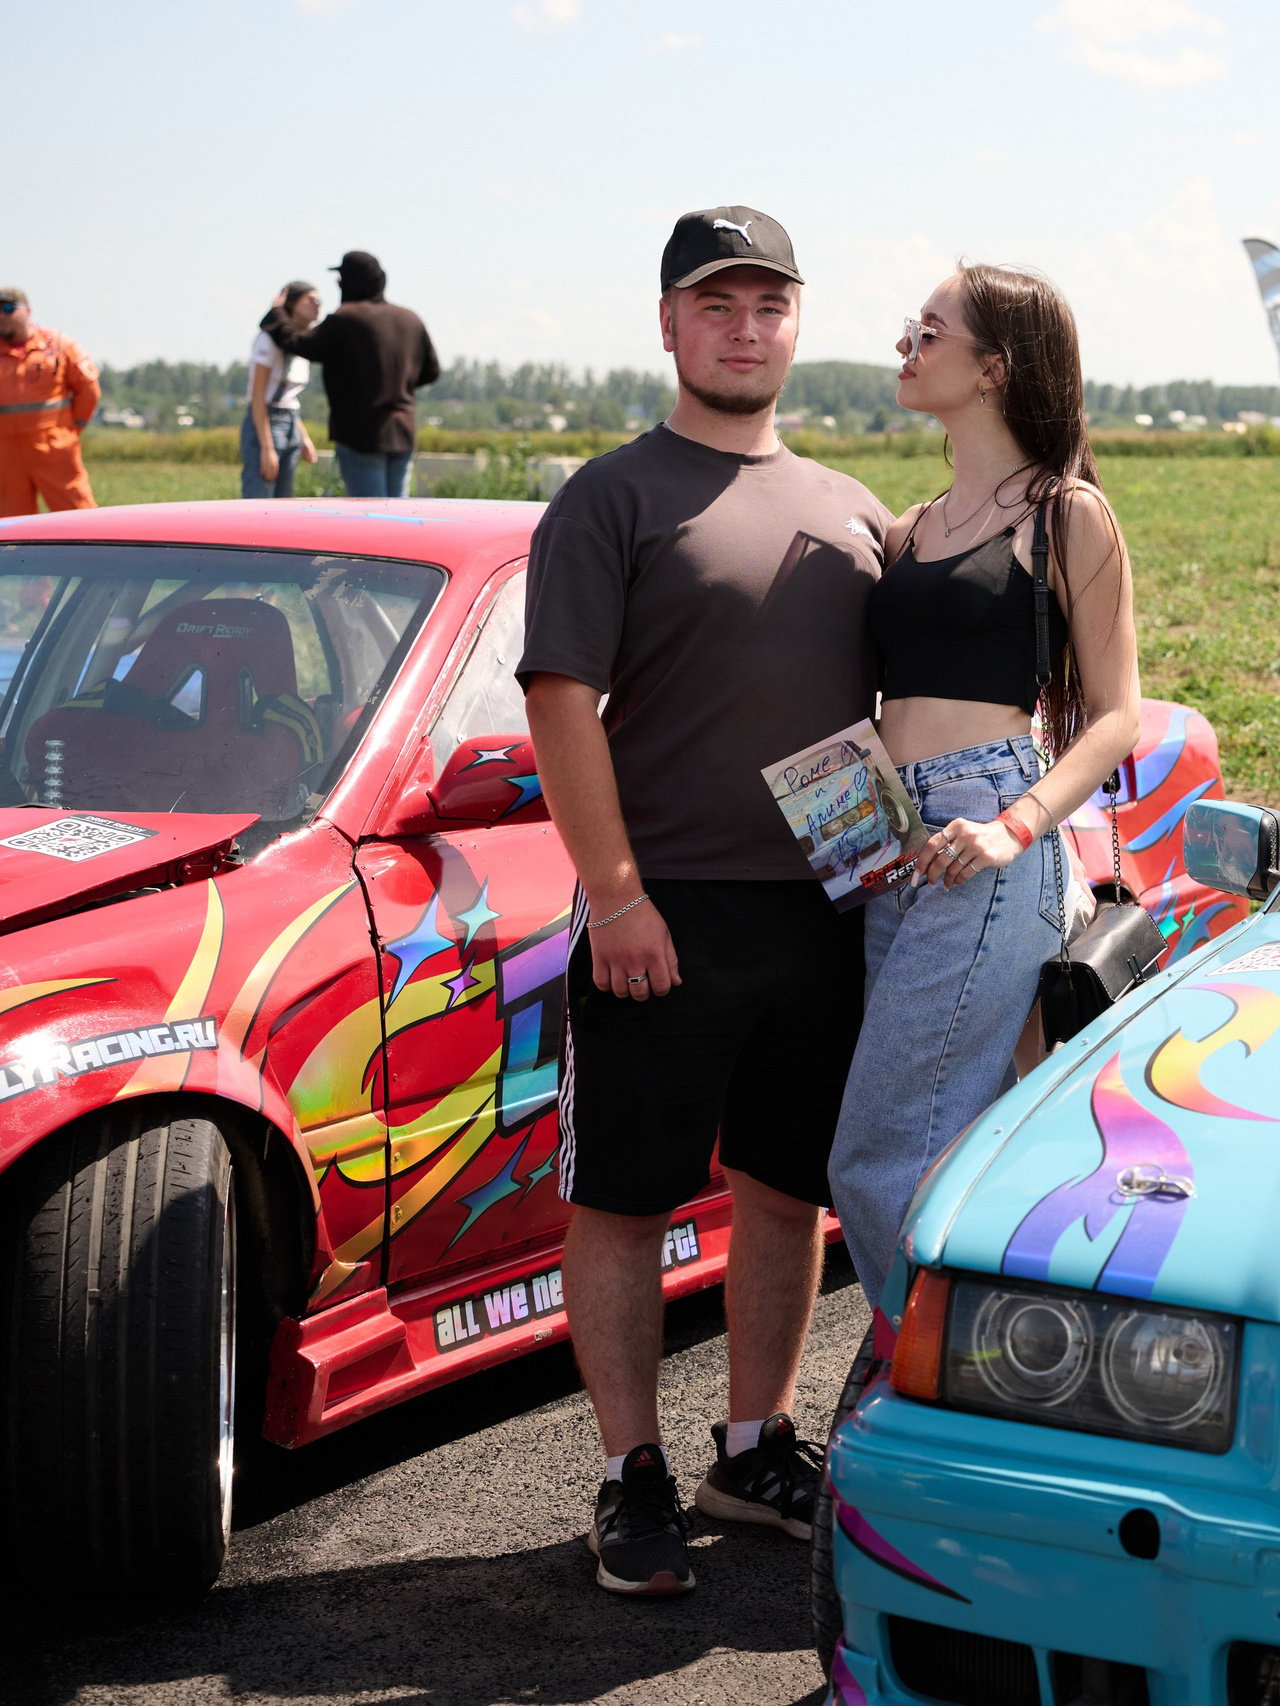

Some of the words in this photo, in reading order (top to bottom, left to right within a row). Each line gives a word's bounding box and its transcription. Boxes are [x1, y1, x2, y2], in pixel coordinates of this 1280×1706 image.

[176, 622, 214, 634] DRIFT
[784, 756, 830, 795] Роме
[860, 854, 905, 888] DRIFT
[885, 857, 919, 884] REA
[532, 1269, 564, 1313] ne
